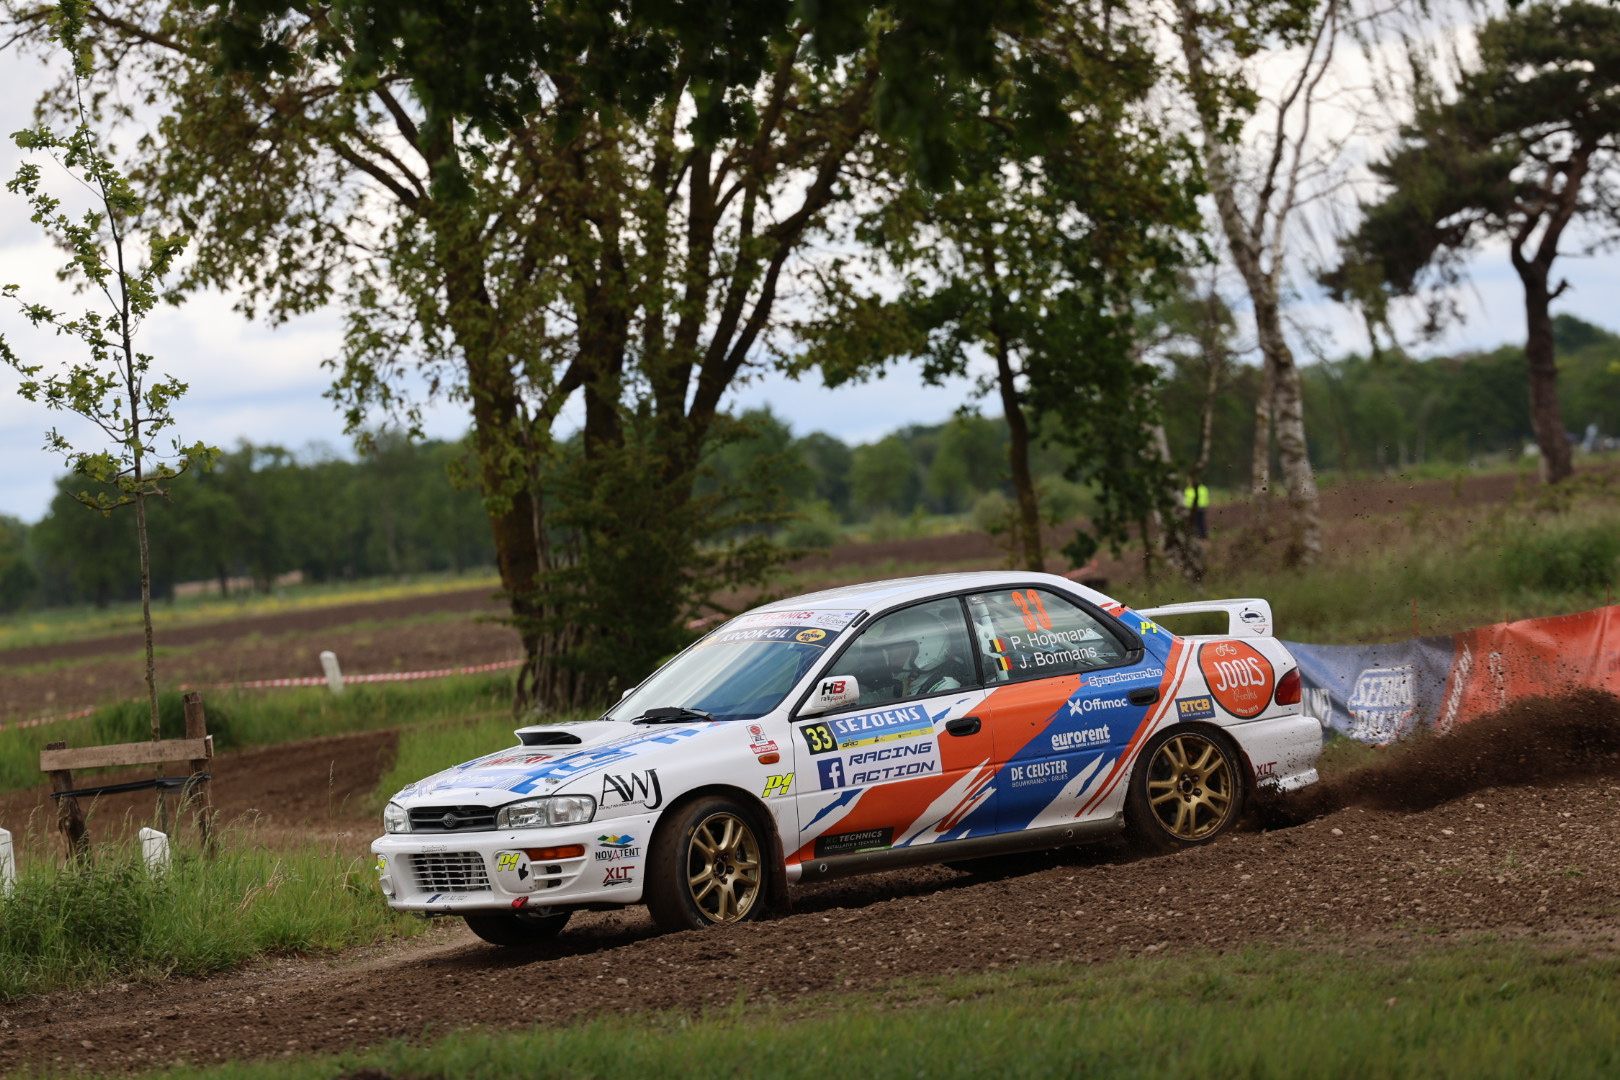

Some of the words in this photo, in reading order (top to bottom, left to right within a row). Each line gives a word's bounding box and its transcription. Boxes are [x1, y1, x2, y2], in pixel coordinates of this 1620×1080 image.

[1011, 589, 1053, 632] 33
[719, 629, 790, 643] KROON-OIL
[1010, 636, 1026, 650] P.
[1027, 627, 1095, 648] Hopmans
[1020, 654, 1032, 669] J.
[1034, 646, 1097, 667] Bormans
[1088, 668, 1163, 687] Speedwear.be
[1213, 657, 1266, 692] JOOLS
[822, 680, 846, 695] HB
[1082, 698, 1128, 712] Offimac
[1179, 698, 1211, 713] RTCB
[835, 707, 920, 734] SEZOENS
[805, 726, 833, 751] 33
[1051, 723, 1111, 748] eurorent
[848, 742, 932, 766] RACING
[852, 760, 935, 785] ACTION
[1011, 766, 1023, 781] DE
[1026, 760, 1068, 779] CEUSTER
[1256, 761, 1278, 776] XLT
[599, 768, 663, 810] AWJ
[839, 830, 883, 843] TECHNICS
[595, 847, 641, 862] NOVATENT
[602, 865, 635, 884] XLT
